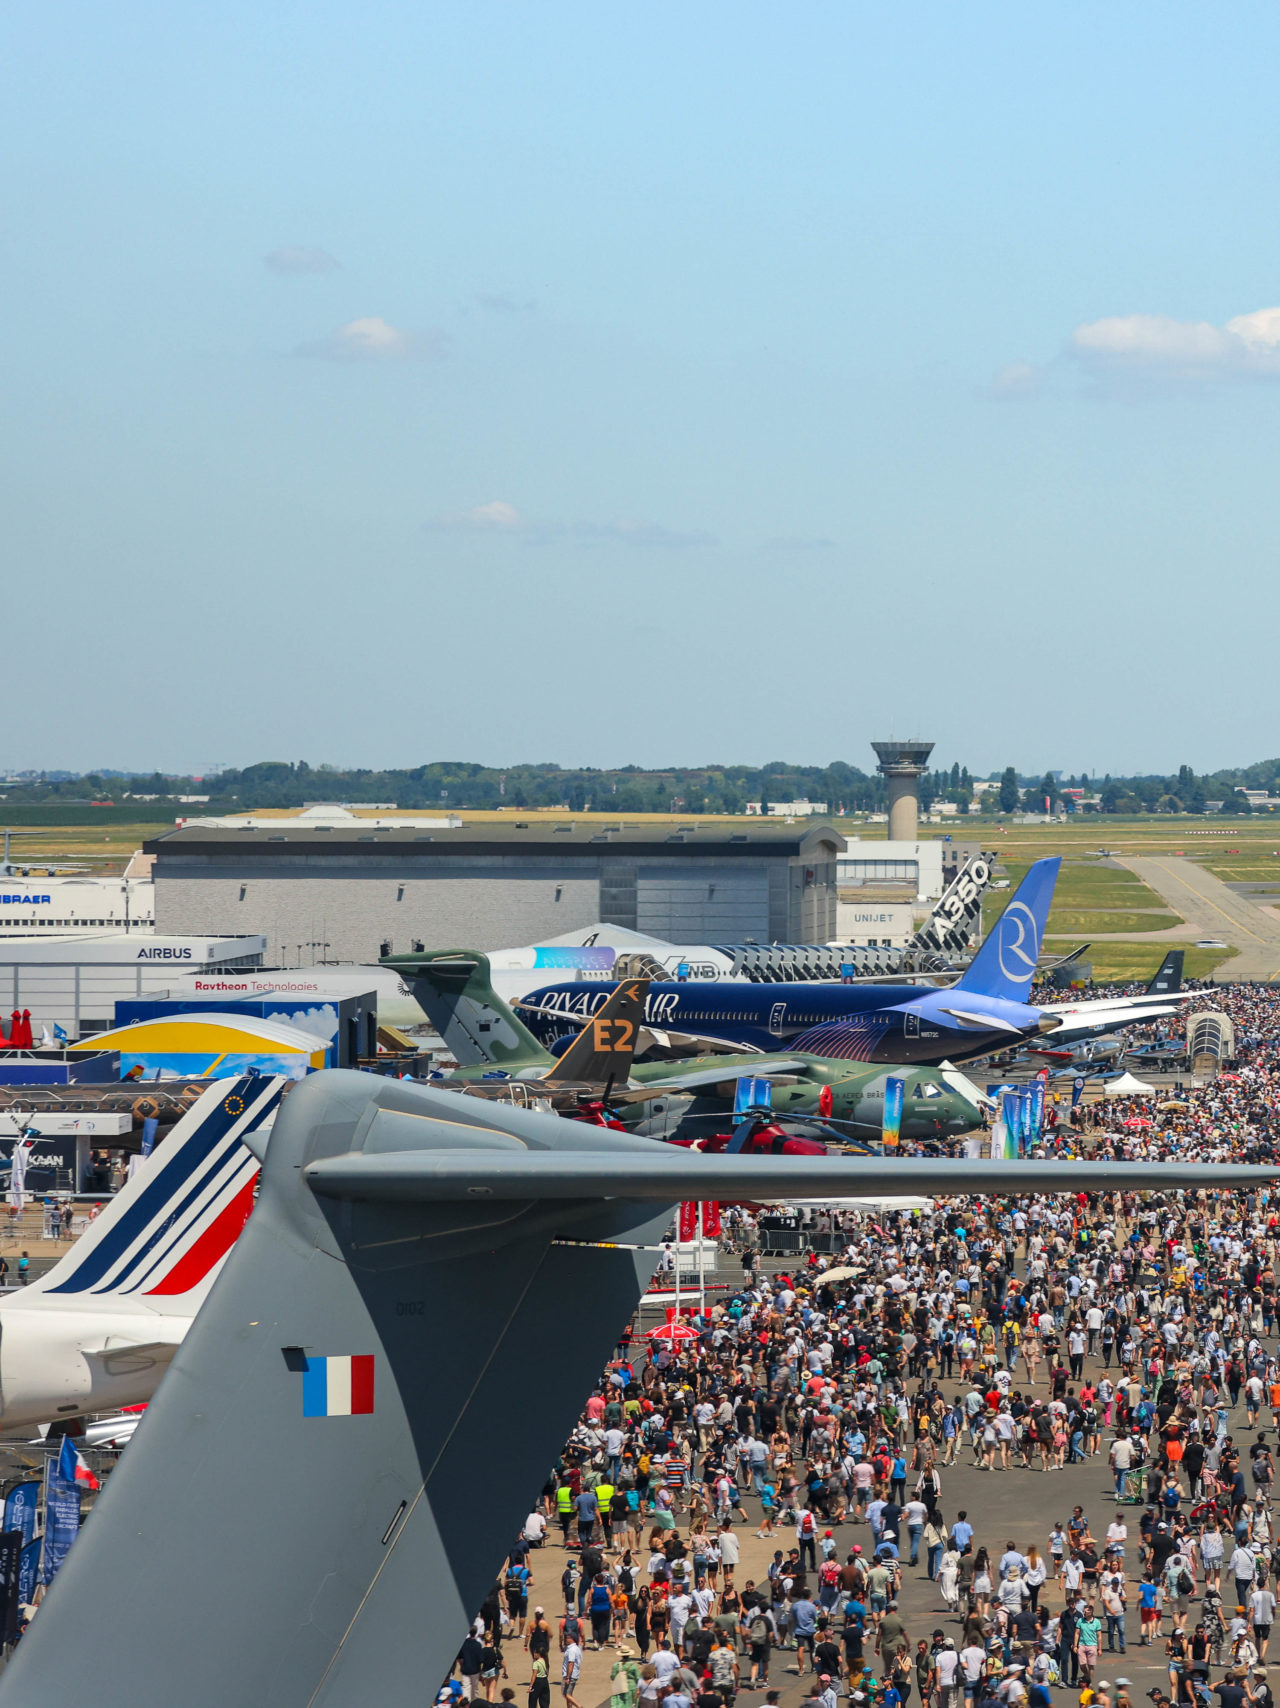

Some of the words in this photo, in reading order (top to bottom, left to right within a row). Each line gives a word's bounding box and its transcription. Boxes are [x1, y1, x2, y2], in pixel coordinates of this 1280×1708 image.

[0, 894, 51, 904] BRAER
[934, 860, 989, 943] A350
[854, 913, 894, 923] UNIJET
[137, 948, 192, 959] AIRBUS
[250, 981, 318, 991] Technologies
[537, 992, 611, 1020] RIYAD
[593, 1019, 634, 1052] E2
